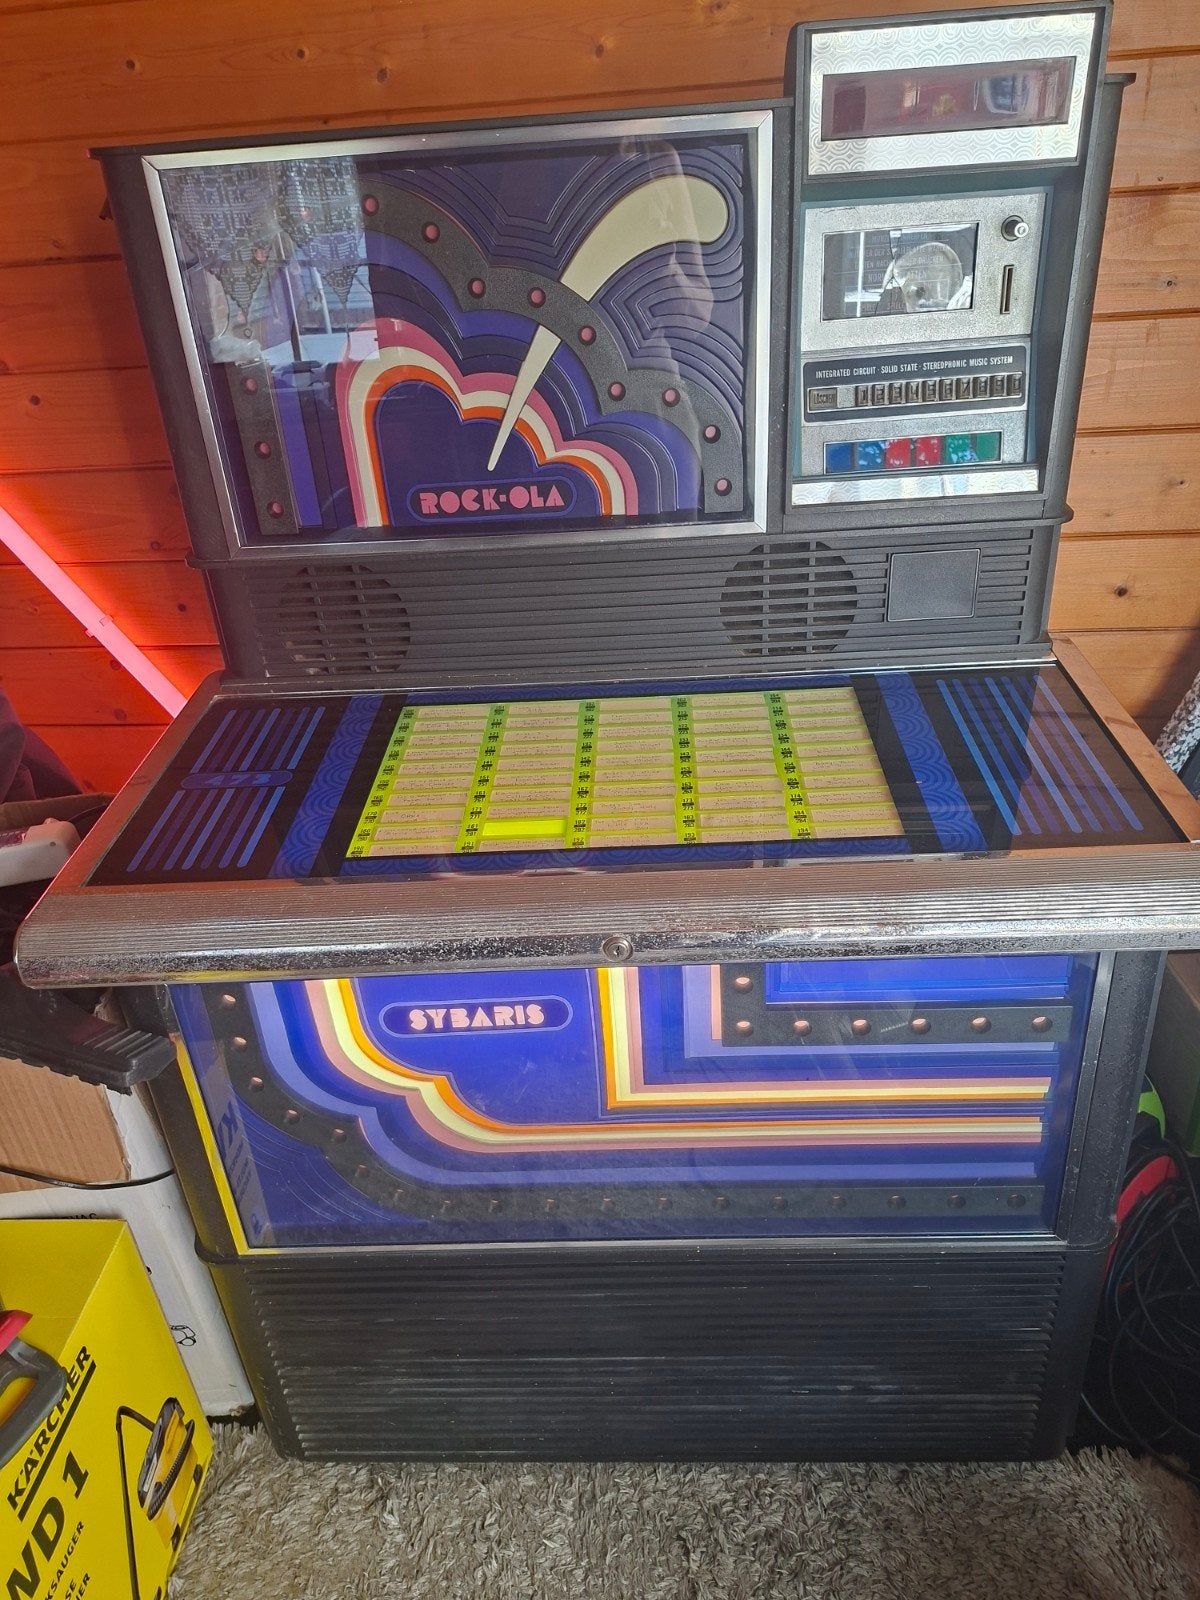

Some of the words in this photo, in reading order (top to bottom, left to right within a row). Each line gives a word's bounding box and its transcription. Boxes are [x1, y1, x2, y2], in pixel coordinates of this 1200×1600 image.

[815, 368, 851, 378] INTEGRATED
[853, 366, 876, 376] CIRCUIT
[881, 365, 898, 374] SOLID
[900, 364, 918, 372] STATE
[922, 358, 967, 370] STEREOPHONIC
[970, 356, 988, 366] MUSIC
[990, 355, 1013, 365] SYSTEM
[419, 484, 565, 514] ROCK-OLA
[408, 1003, 545, 1031] SYBARIS
[62, 1450, 89, 1500] 1
